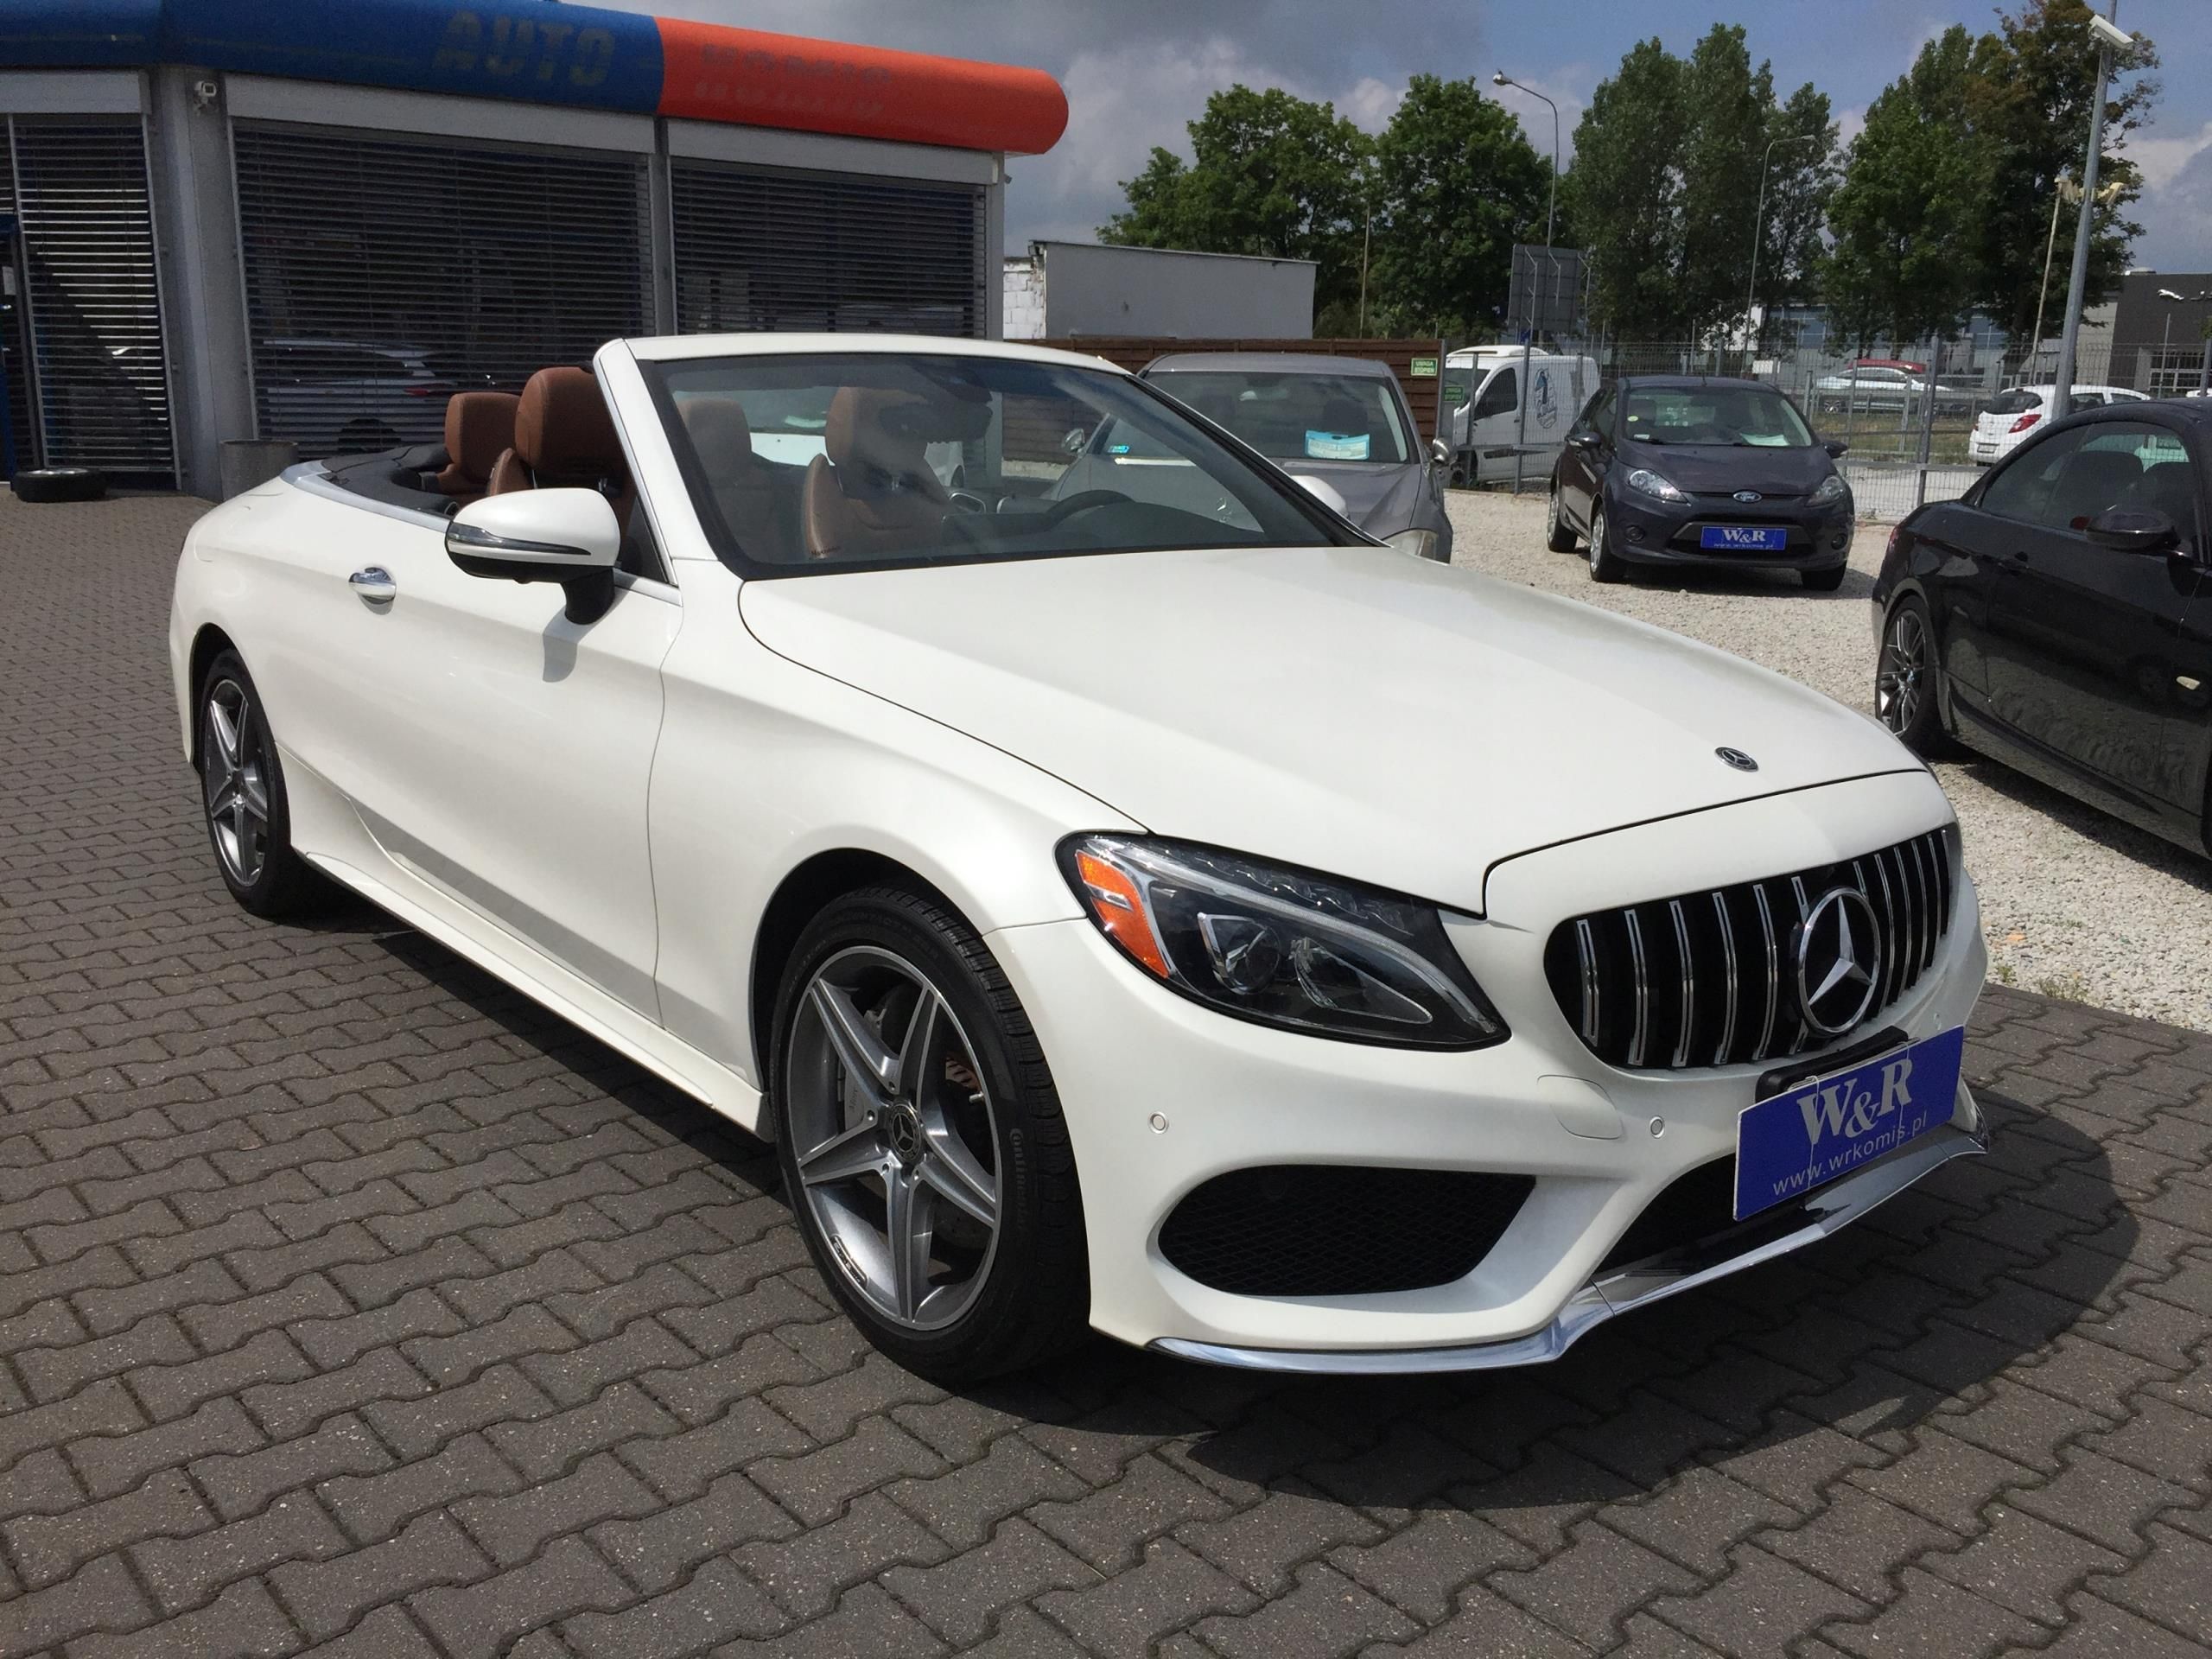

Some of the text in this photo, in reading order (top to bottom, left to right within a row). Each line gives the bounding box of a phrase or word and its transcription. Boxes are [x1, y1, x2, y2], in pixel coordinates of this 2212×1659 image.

[433, 11, 617, 86] AUTO
[1722, 530, 1766, 543] W&R
[1796, 1058, 1913, 1146] W&R
[1772, 1110, 1928, 1197] www.wrkomis.pl
